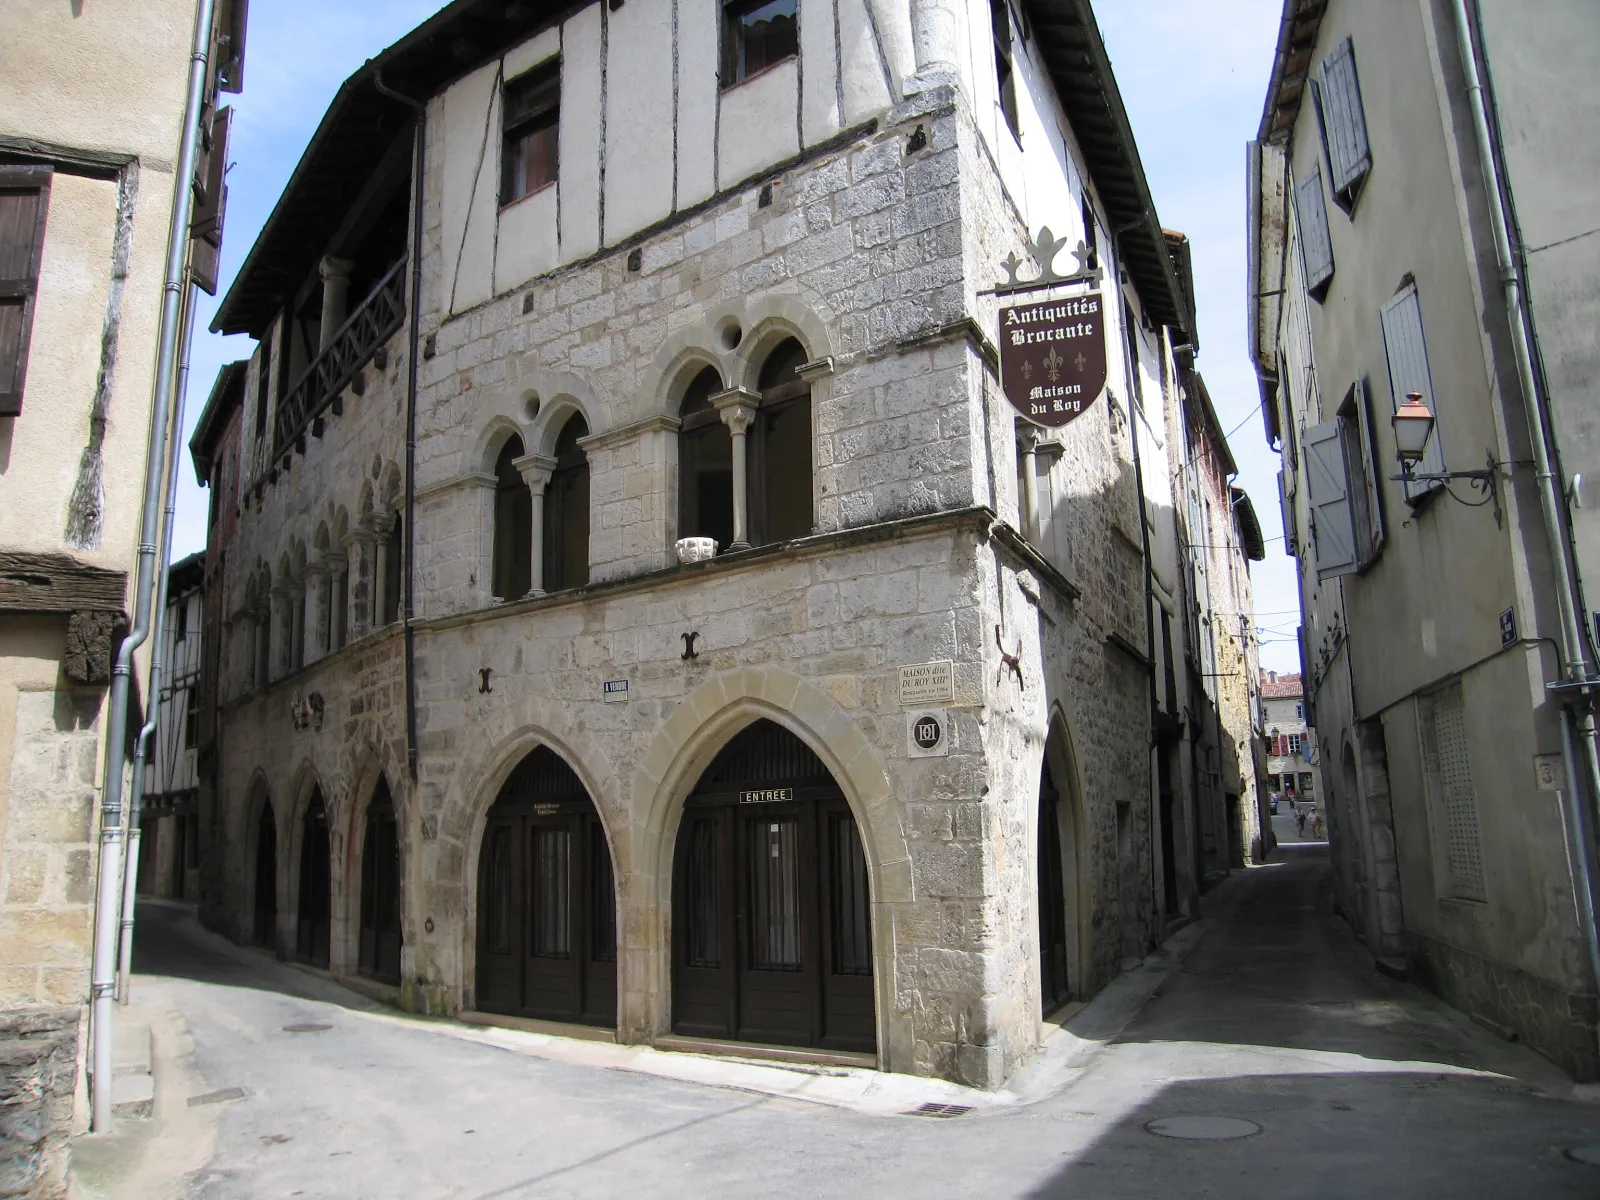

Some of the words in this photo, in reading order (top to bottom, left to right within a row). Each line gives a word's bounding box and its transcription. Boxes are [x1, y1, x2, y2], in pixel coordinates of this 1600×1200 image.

[1004, 297, 1098, 326] Antiquités
[1010, 322, 1093, 346] Brocante
[1029, 384, 1081, 400] Maison
[1031, 403, 1047, 415] du
[1053, 399, 1081, 412] Roy
[903, 667, 930, 678] MAISON
[610, 680, 627, 691] VENDRE
[902, 679, 912, 688] DU
[914, 677, 930, 687] ROY
[746, 791, 786, 801] ENTREE
